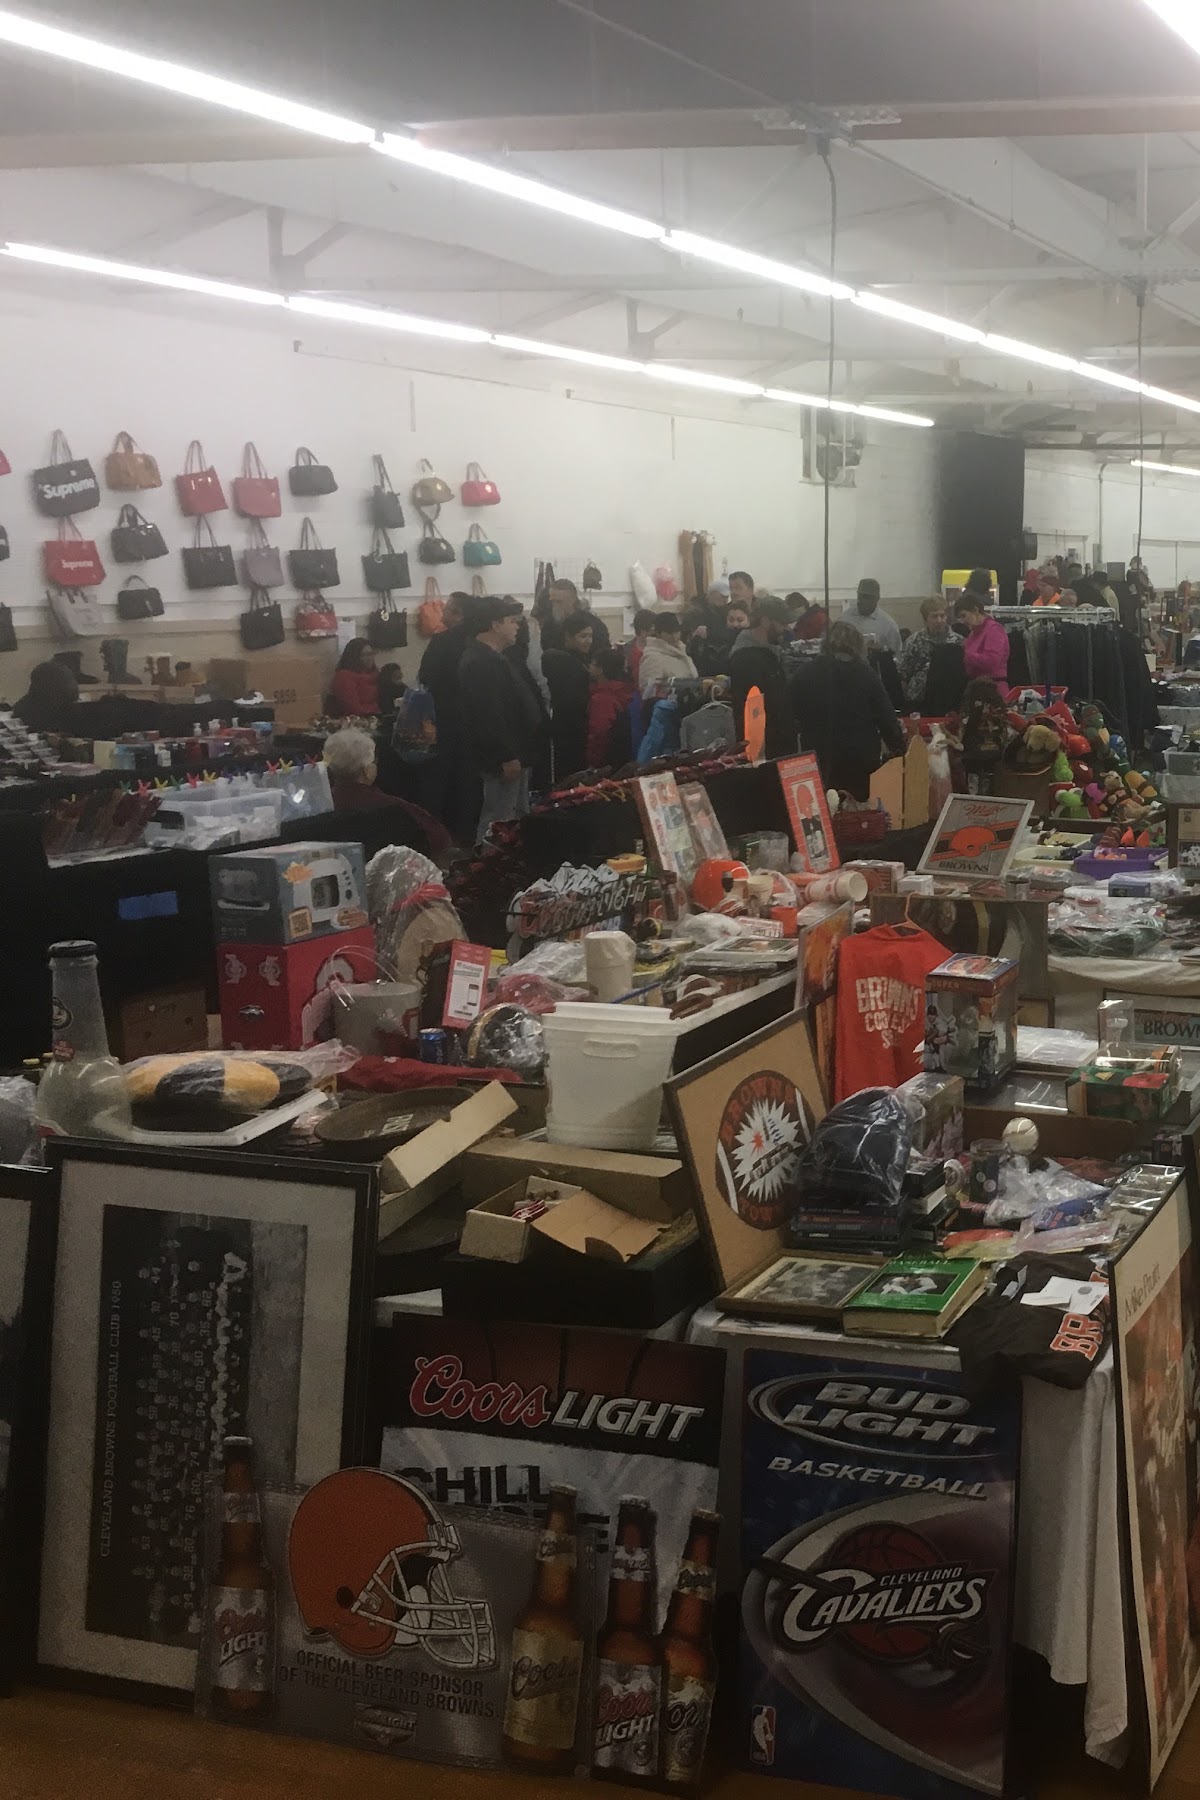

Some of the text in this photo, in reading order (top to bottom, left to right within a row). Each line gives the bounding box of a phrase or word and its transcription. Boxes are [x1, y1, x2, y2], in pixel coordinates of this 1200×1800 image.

[43, 477, 95, 499] Supreme
[61, 559, 94, 571] Supreme
[939, 861, 989, 873] BROWNS
[856, 976, 922, 1021] BROWNS
[100, 1280, 123, 1558] CLEVELAND BROWNS FOOTBALL CLUB 1950
[409, 1354, 705, 1442] Coors LIGHT
[815, 1381, 972, 1417] BUD
[782, 1403, 998, 1447] LIGHT
[767, 1456, 988, 1501] BASKETBALL
[880, 1567, 963, 1587] CLEVELAND
[782, 1568, 987, 1643] CAVALIERS
[279, 1665, 298, 1683] OF
[303, 1670, 330, 1689] THE
[334, 1675, 421, 1706] CLEVELAND
[296, 1649, 485, 1698] OFFICIAL BEER SPONSOR
